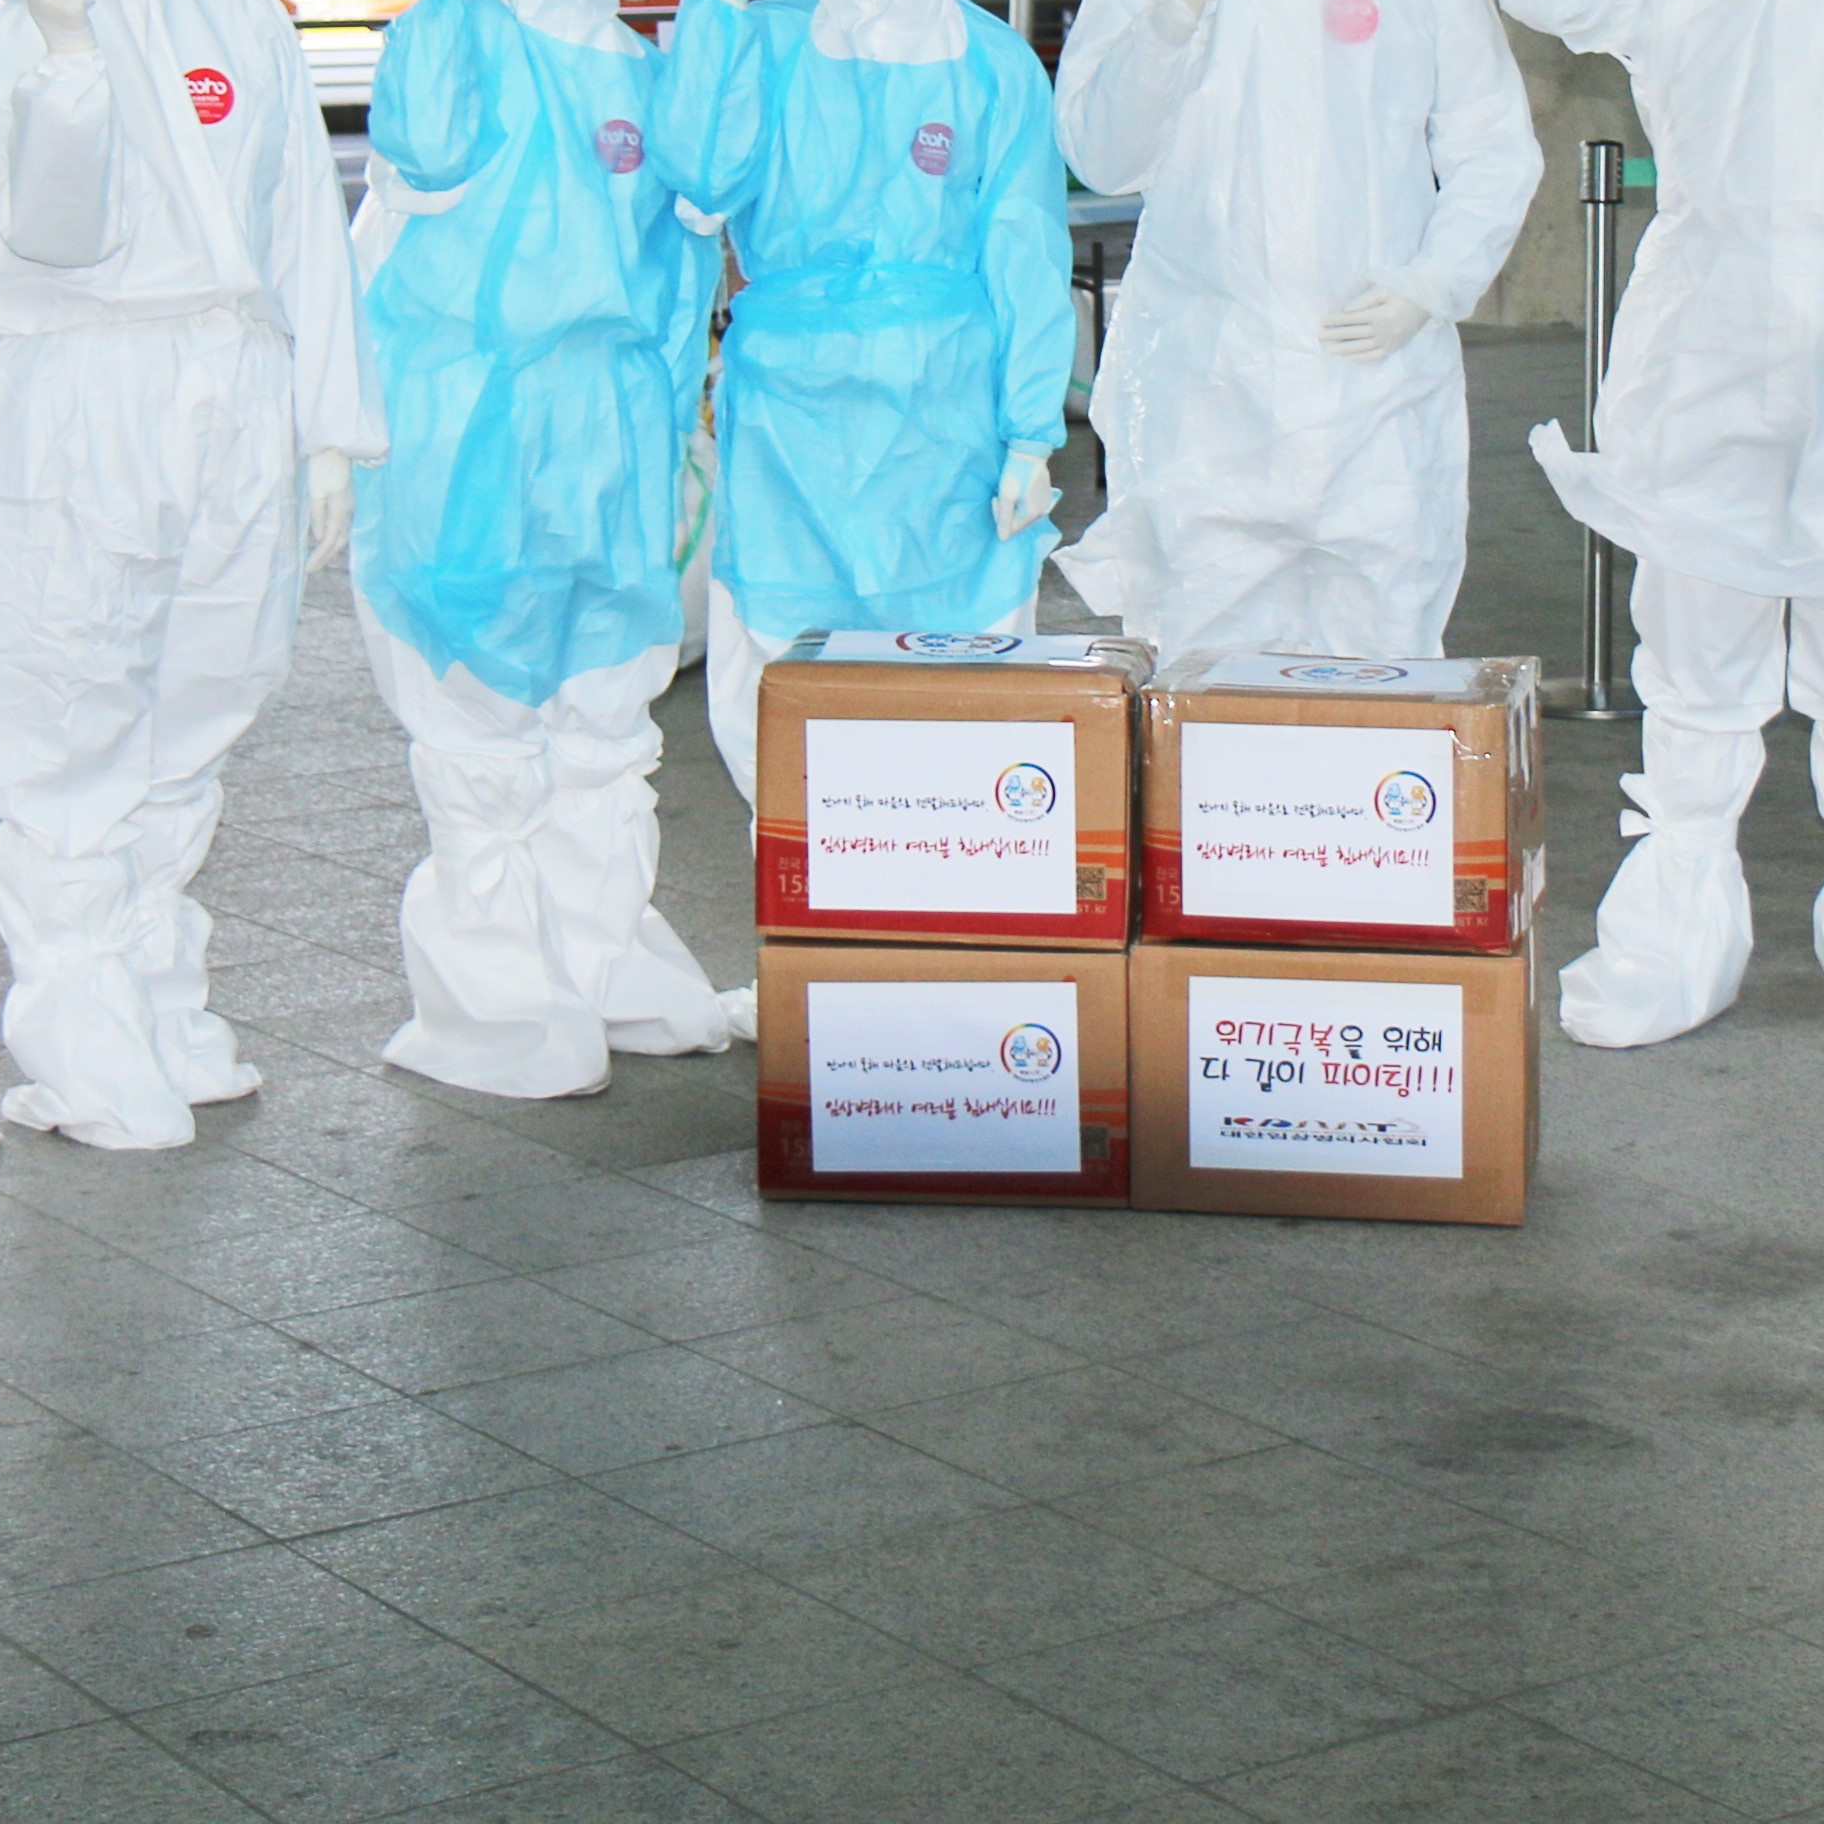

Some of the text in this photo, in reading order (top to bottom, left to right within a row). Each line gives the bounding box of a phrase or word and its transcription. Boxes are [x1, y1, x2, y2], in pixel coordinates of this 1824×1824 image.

[821, 836, 898, 854] 임상병리사
[905, 837, 951, 859] 여러분
[1197, 842, 1275, 860] 임상병리사
[1283, 845, 1329, 867] 여러분
[1215, 1019, 1443, 1060] 위기극복을 위해
[1200, 1056, 1454, 1098] 다 같이 파이팅!!!
[825, 1098, 904, 1117] 임상병리사
[911, 1098, 957, 1120] 여러분
